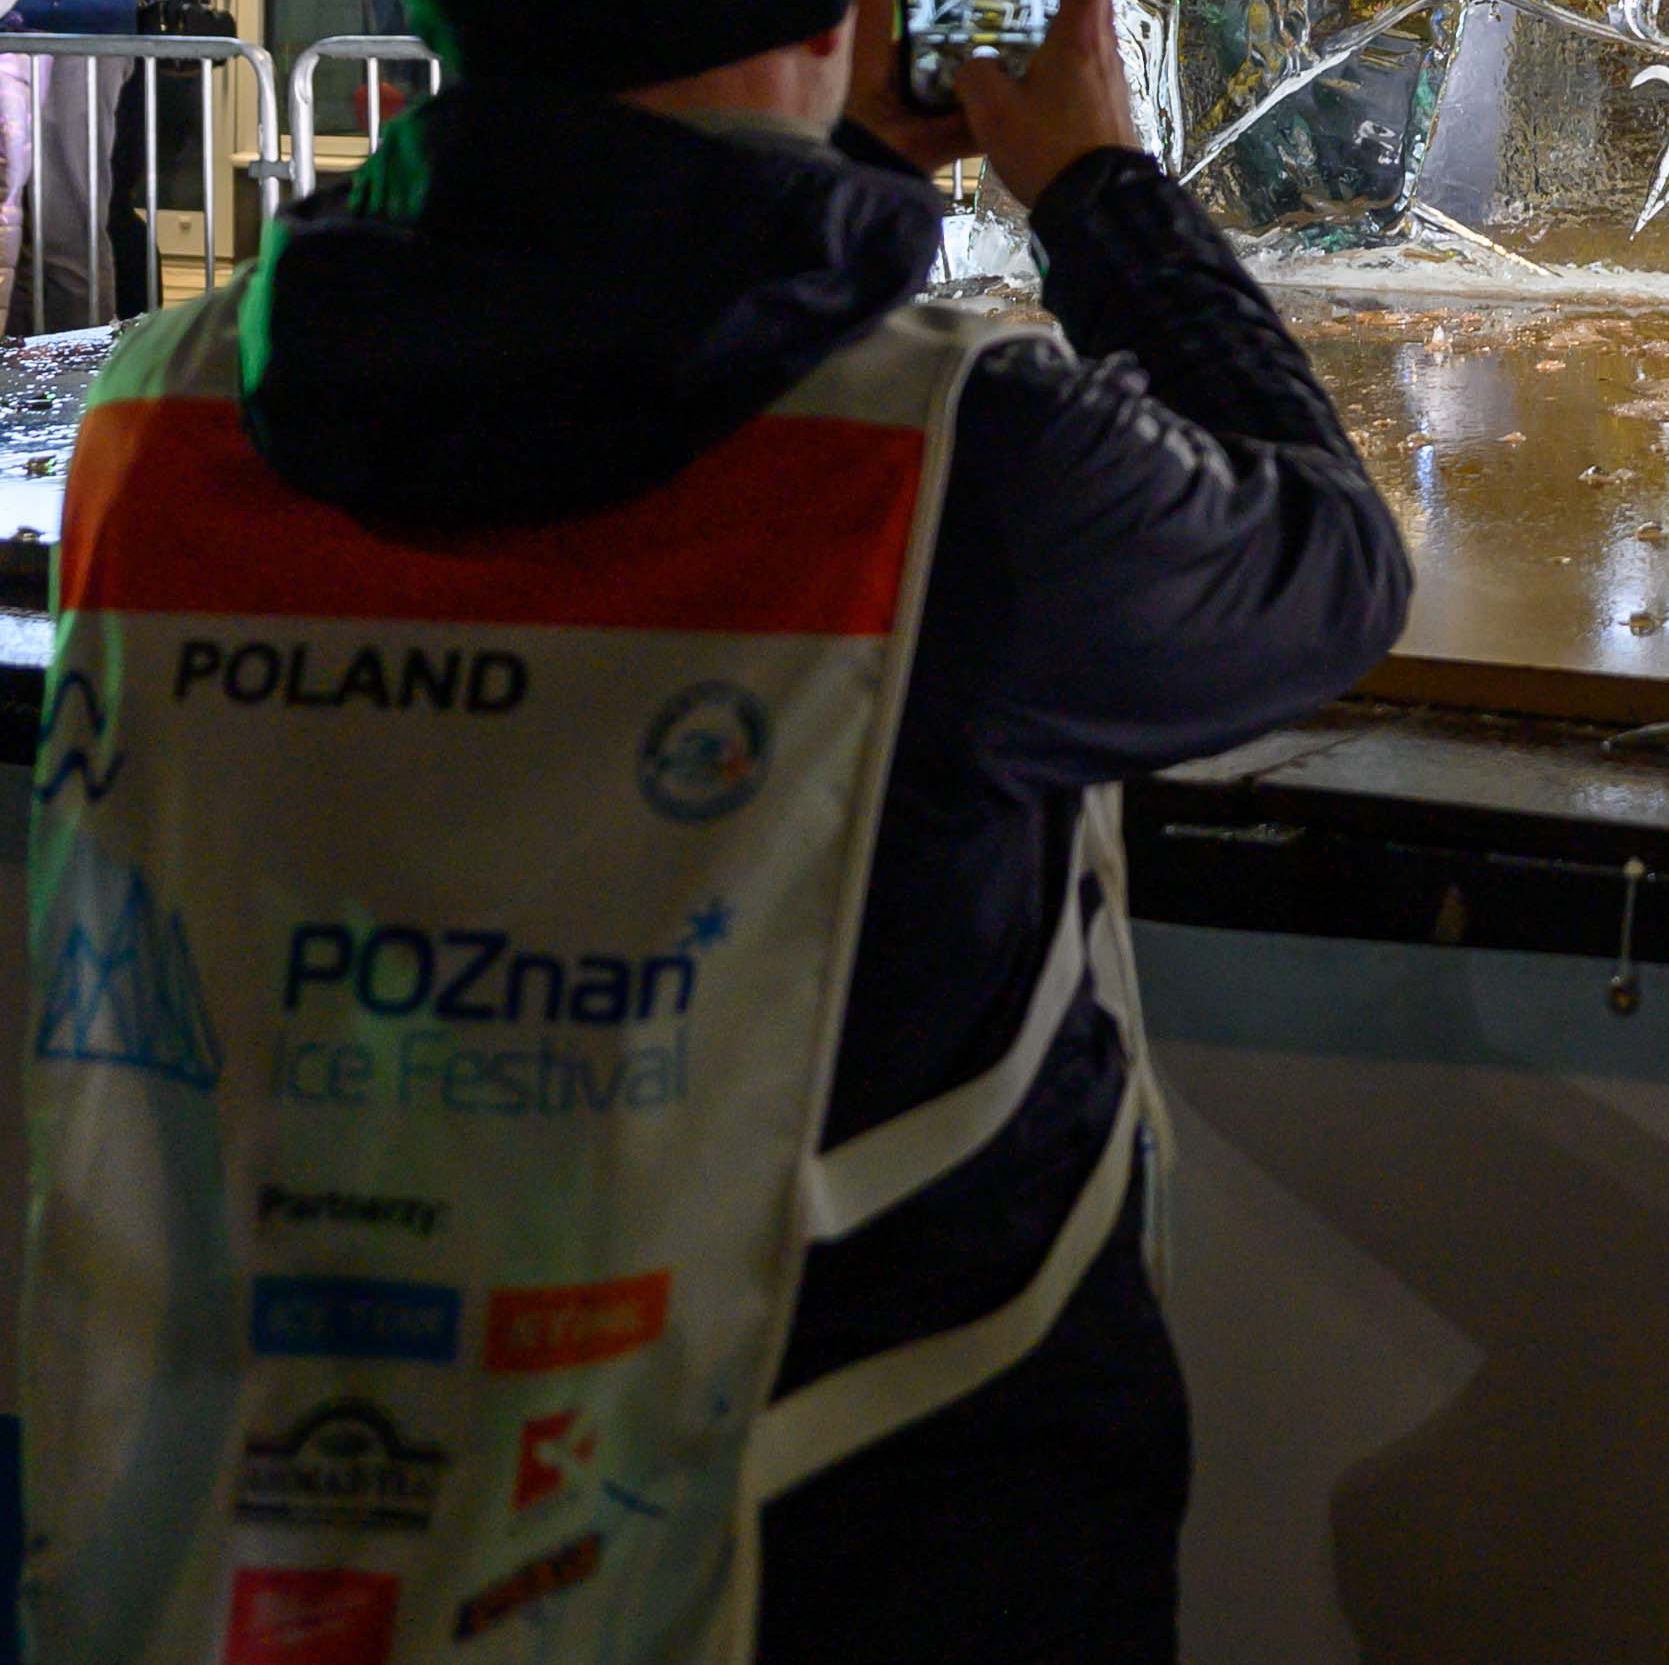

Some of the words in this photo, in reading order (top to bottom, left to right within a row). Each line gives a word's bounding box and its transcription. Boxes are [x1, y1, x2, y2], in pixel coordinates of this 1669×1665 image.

[172, 640, 530, 715] POLAND
[272, 1029, 369, 1108] Ice
[397, 1027, 689, 1120] Festival
